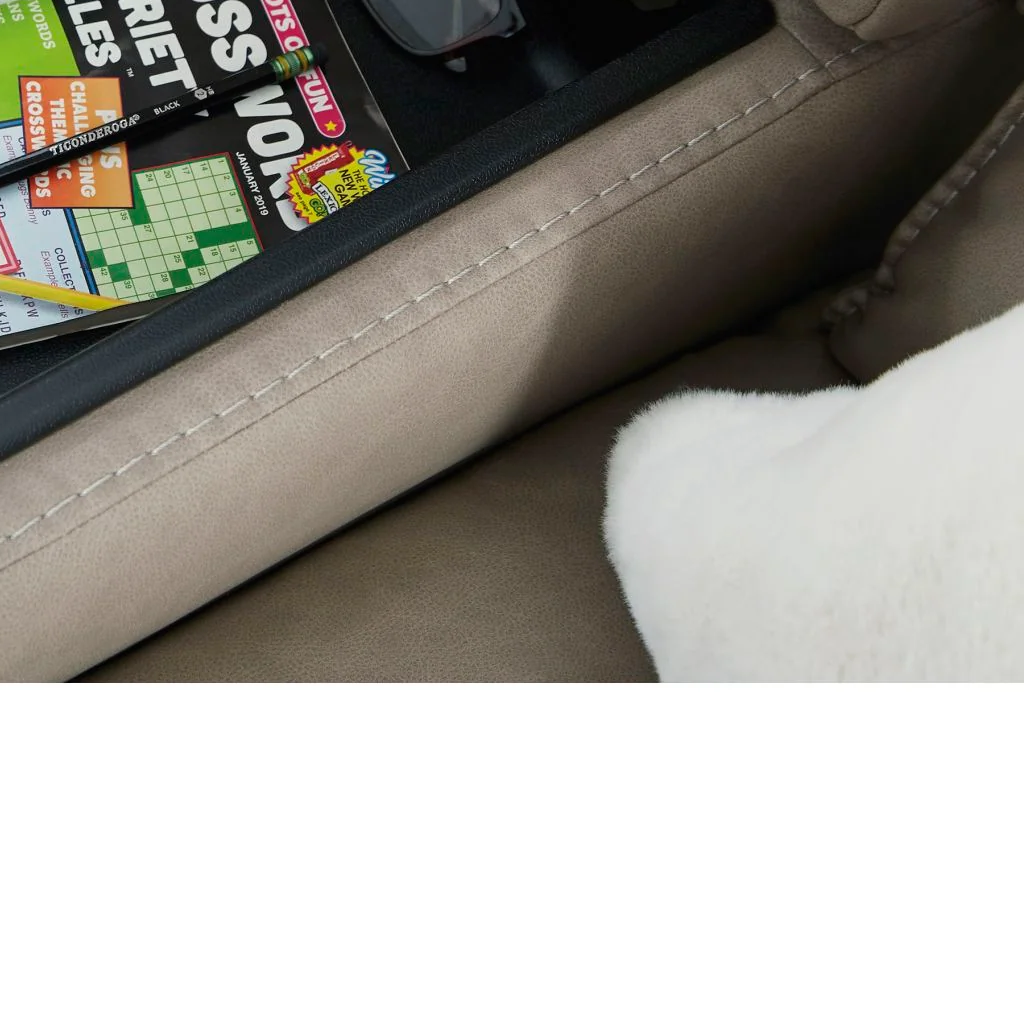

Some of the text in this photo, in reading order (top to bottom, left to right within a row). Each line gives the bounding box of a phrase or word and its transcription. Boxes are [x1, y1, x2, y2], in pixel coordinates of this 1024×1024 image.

[153, 101, 179, 115] BLACK
[298, 69, 332, 114] FUN
[25, 81, 50, 198] CROSSWDS
[50, 98, 69, 180] THEMIC
[70, 81, 96, 198] CHALLGING
[94, 109, 123, 169] PS
[235, 152, 268, 215] JANUARY 2019
[314, 184, 337, 212] LEXIC
[339, 168, 356, 191] NEW
[352, 169, 363, 183] THE
[357, 150, 396, 190] Wi
[119, 210, 128, 220] 35
[144, 172, 153, 182] 24
[173, 253, 182, 264] 25
[163, 169, 206, 277] 20 21 22
[181, 165, 218, 257] 17 18
[199, 162, 236, 253] 14 15
[98, 266, 107, 276] 42
[143, 223, 169, 282] 27 28
[123, 279, 132, 289] 39
